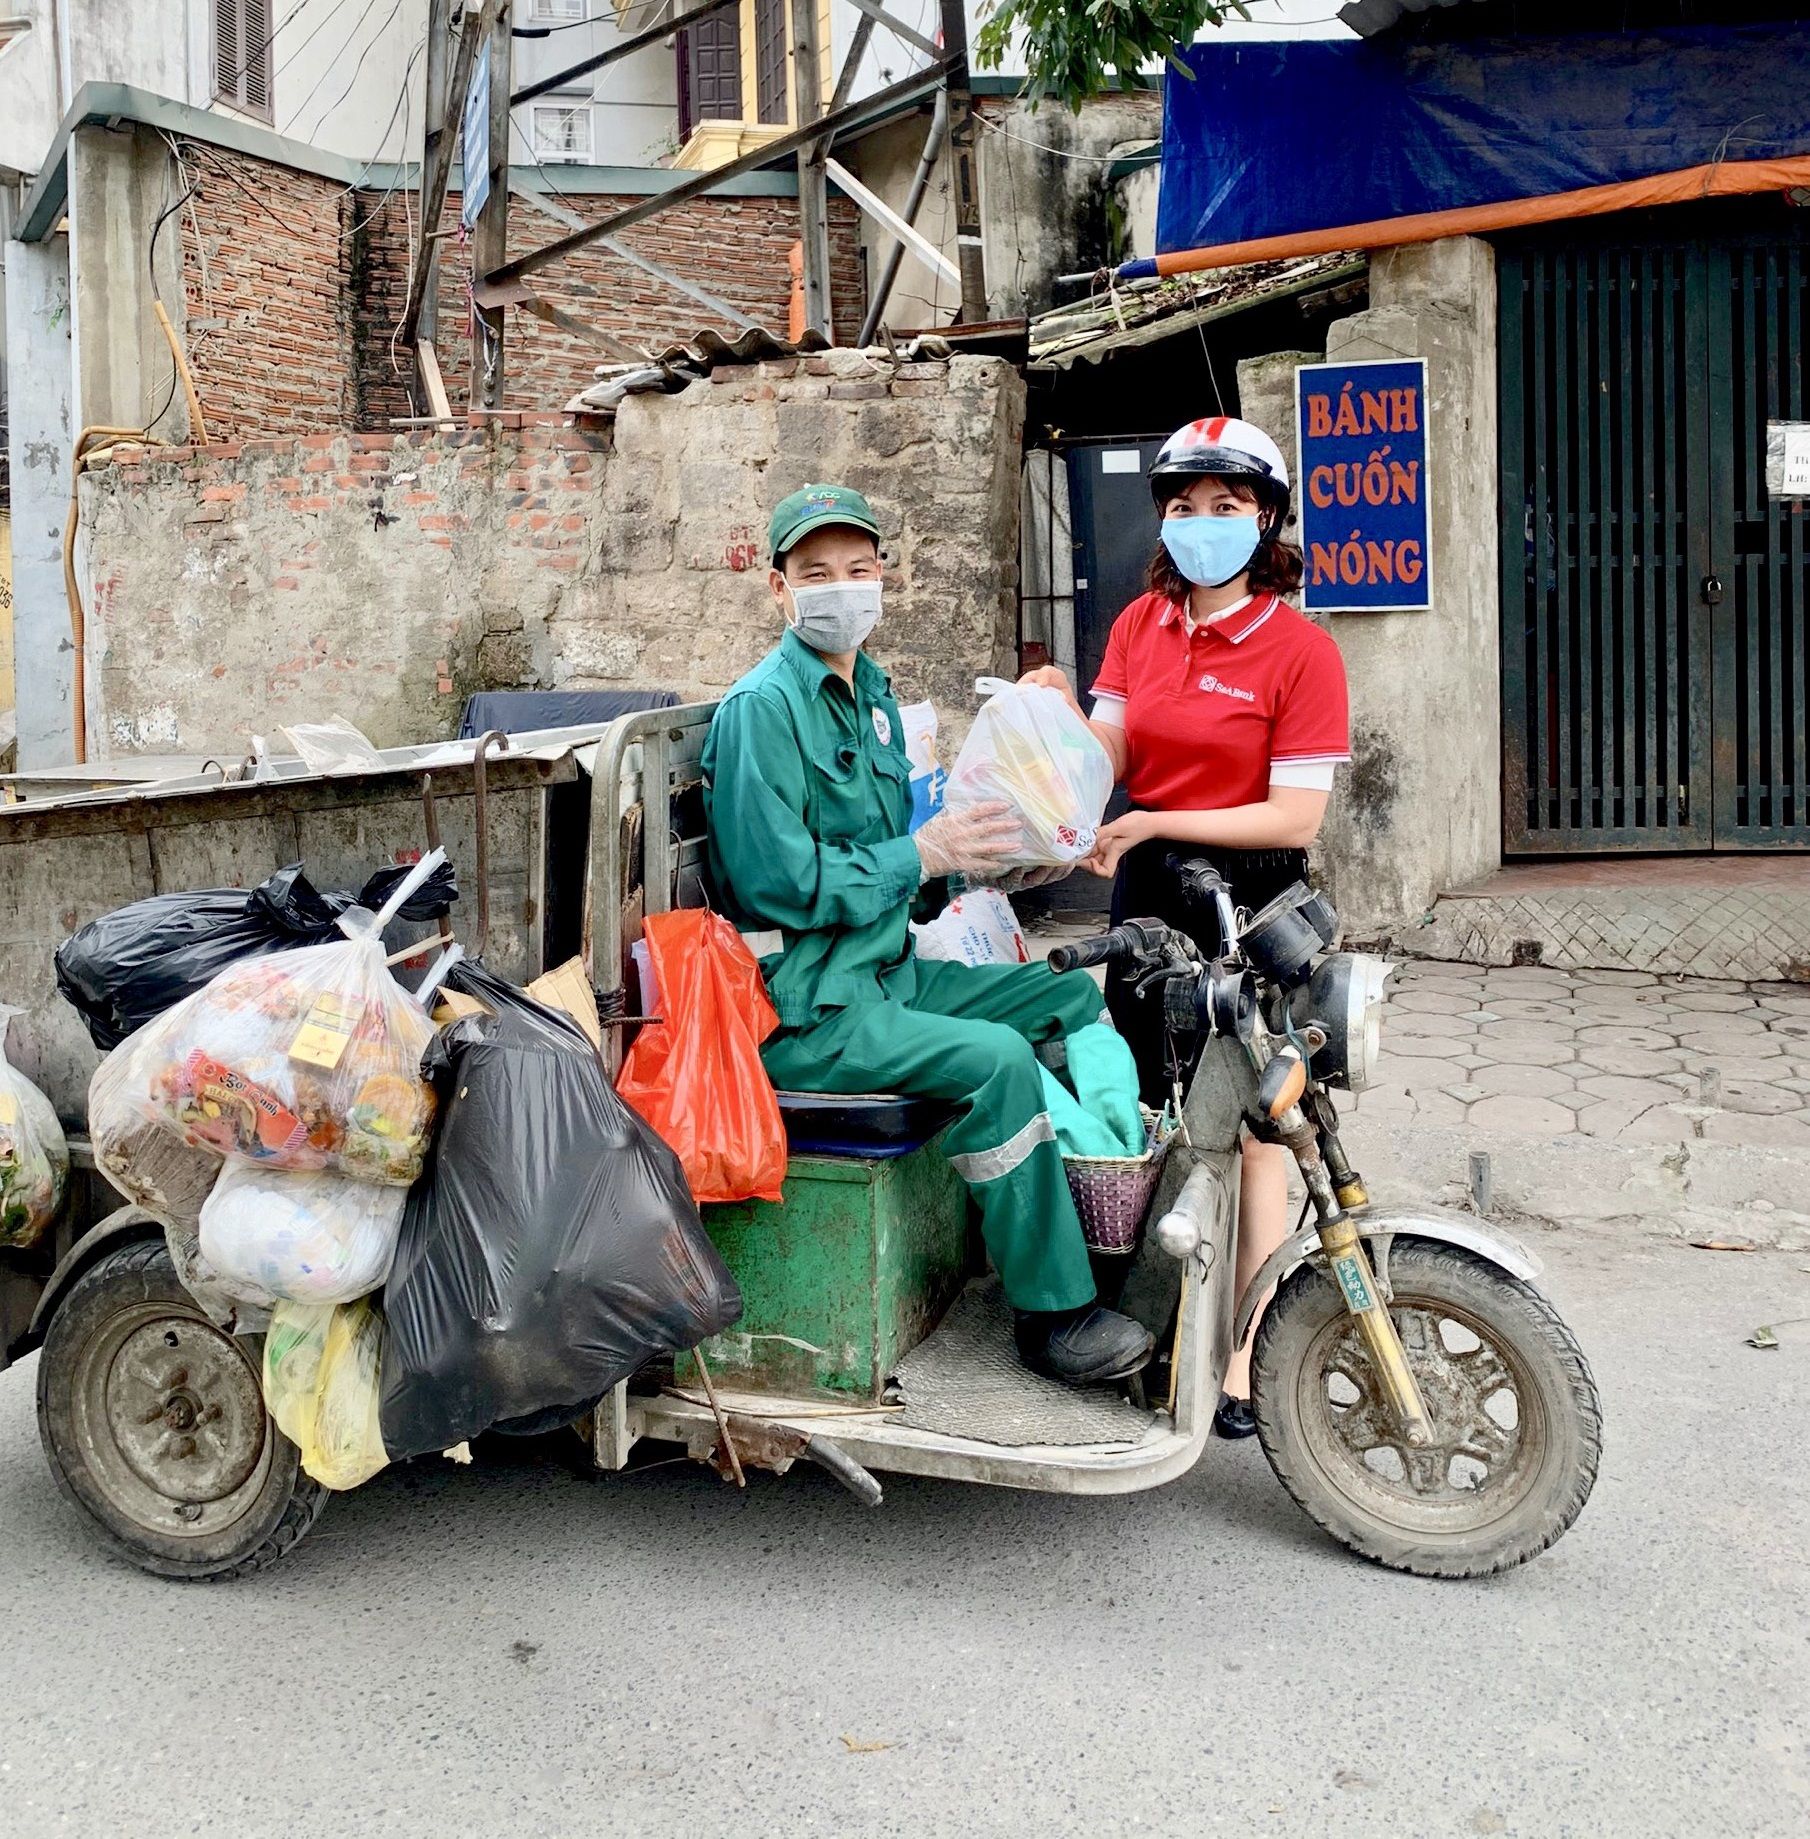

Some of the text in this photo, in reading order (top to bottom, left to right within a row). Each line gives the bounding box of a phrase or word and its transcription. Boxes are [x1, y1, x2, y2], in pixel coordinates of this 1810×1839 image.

[1307, 381, 1418, 437] BÁNH
[1308, 445, 1419, 508] CUỐN
[1310, 530, 1423, 586] NÓNG
